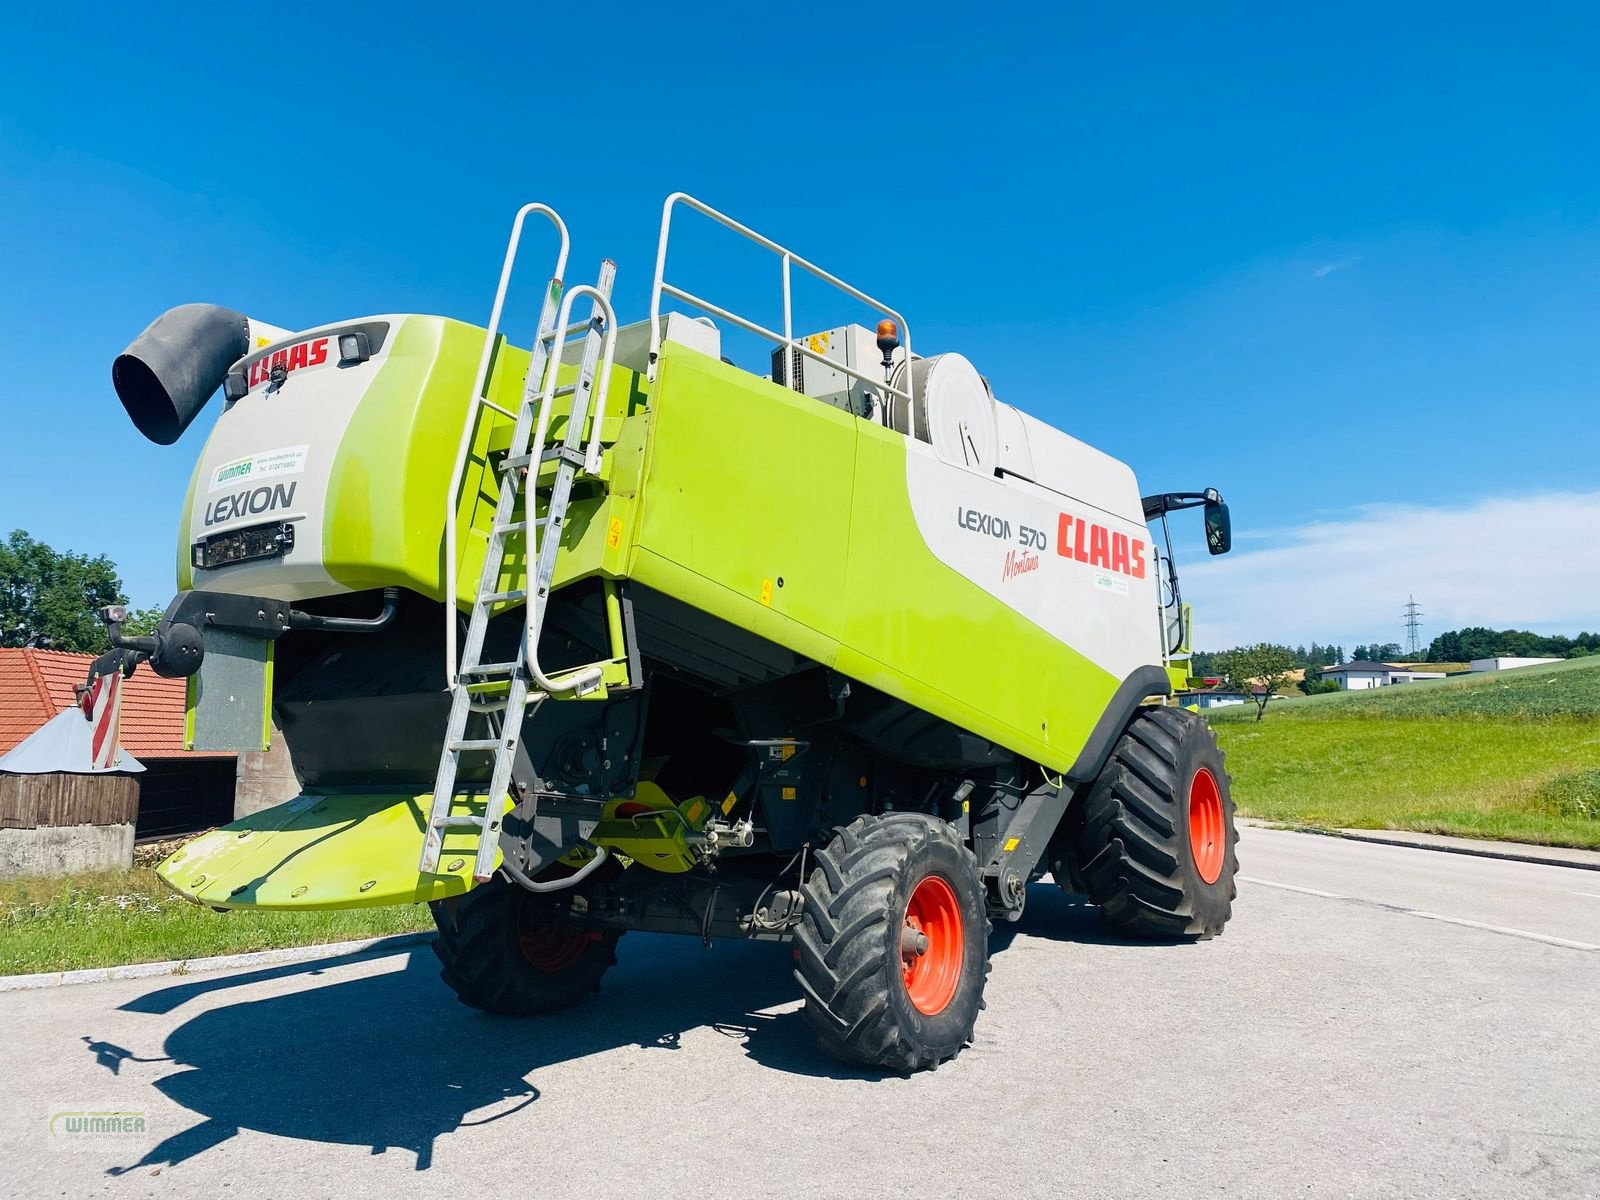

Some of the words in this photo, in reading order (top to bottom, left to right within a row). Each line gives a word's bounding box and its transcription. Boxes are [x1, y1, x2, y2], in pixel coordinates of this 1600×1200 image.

[250, 338, 328, 388] CLAAS
[217, 462, 253, 482] WIMMER
[204, 481, 298, 526] LEXION
[957, 506, 1012, 541] LEXION
[1018, 525, 1047, 551] 570
[1056, 511, 1146, 580] CLAAS
[1002, 549, 1040, 582] Montana
